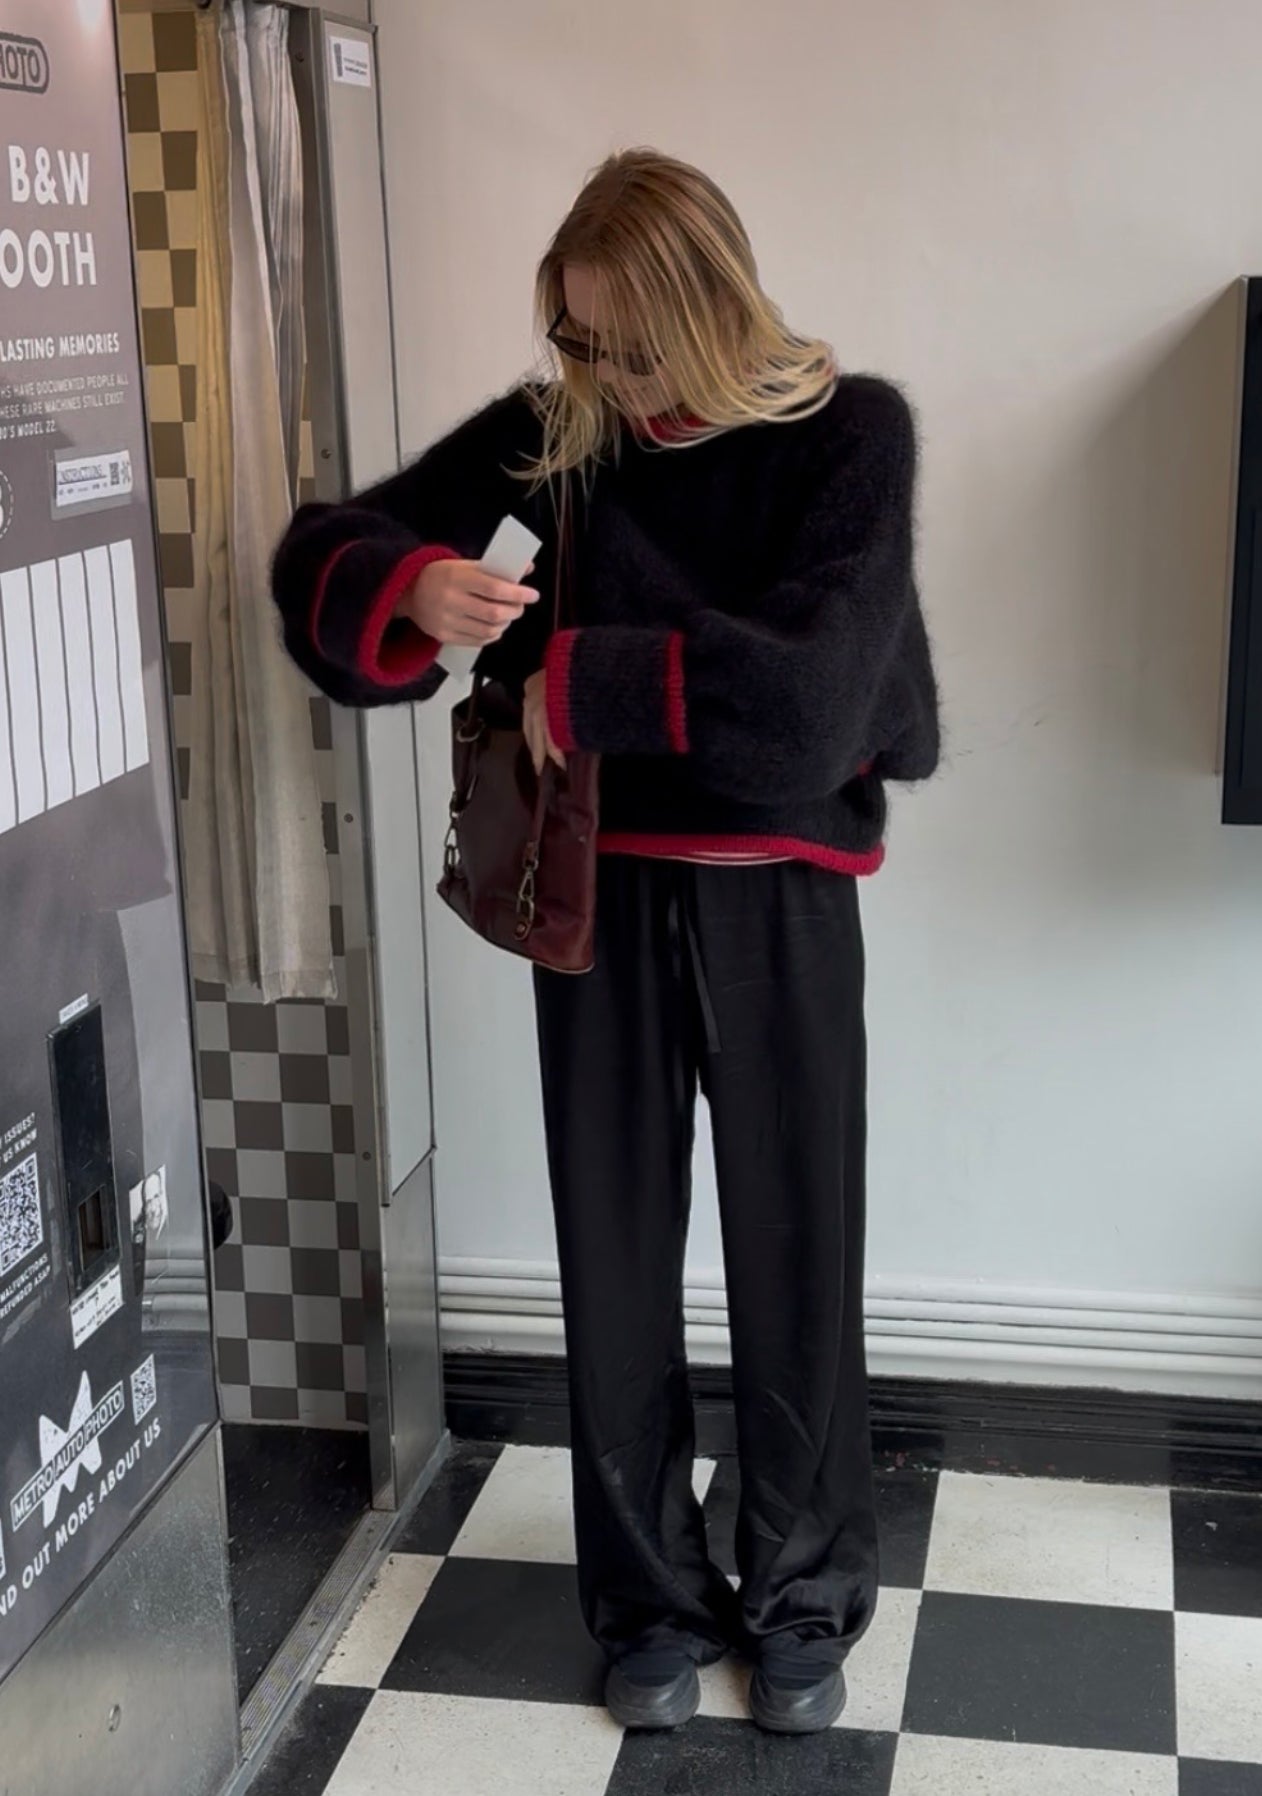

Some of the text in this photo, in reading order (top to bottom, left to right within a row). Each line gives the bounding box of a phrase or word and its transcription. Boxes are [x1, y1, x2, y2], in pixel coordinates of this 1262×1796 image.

[8, 145, 90, 206] B&W
[0, 228, 97, 289] OOTH
[0, 332, 120, 362] LASTING MEMORIES
[13, 383, 35, 397] HAVE
[36, 377, 85, 395] DOCUMENTED
[86, 374, 115, 389] PEOPLE
[117, 373, 129, 386] ALL
[22, 401, 43, 416] RARE
[44, 396, 82, 413] MACHINES
[82, 393, 103, 408] STILL
[17, 421, 44, 438] MODEL
[4, 1112, 36, 1144] ISSUES?
[14, 1128, 37, 1154] KNOW
[14, 1390, 123, 1523] METRO AUTO PHOTO
[22, 1541, 51, 1590] OUT
[55, 1492, 95, 1553] MORE
[99, 1439, 141, 1503] ABOUT
[144, 1417, 162, 1449] US
